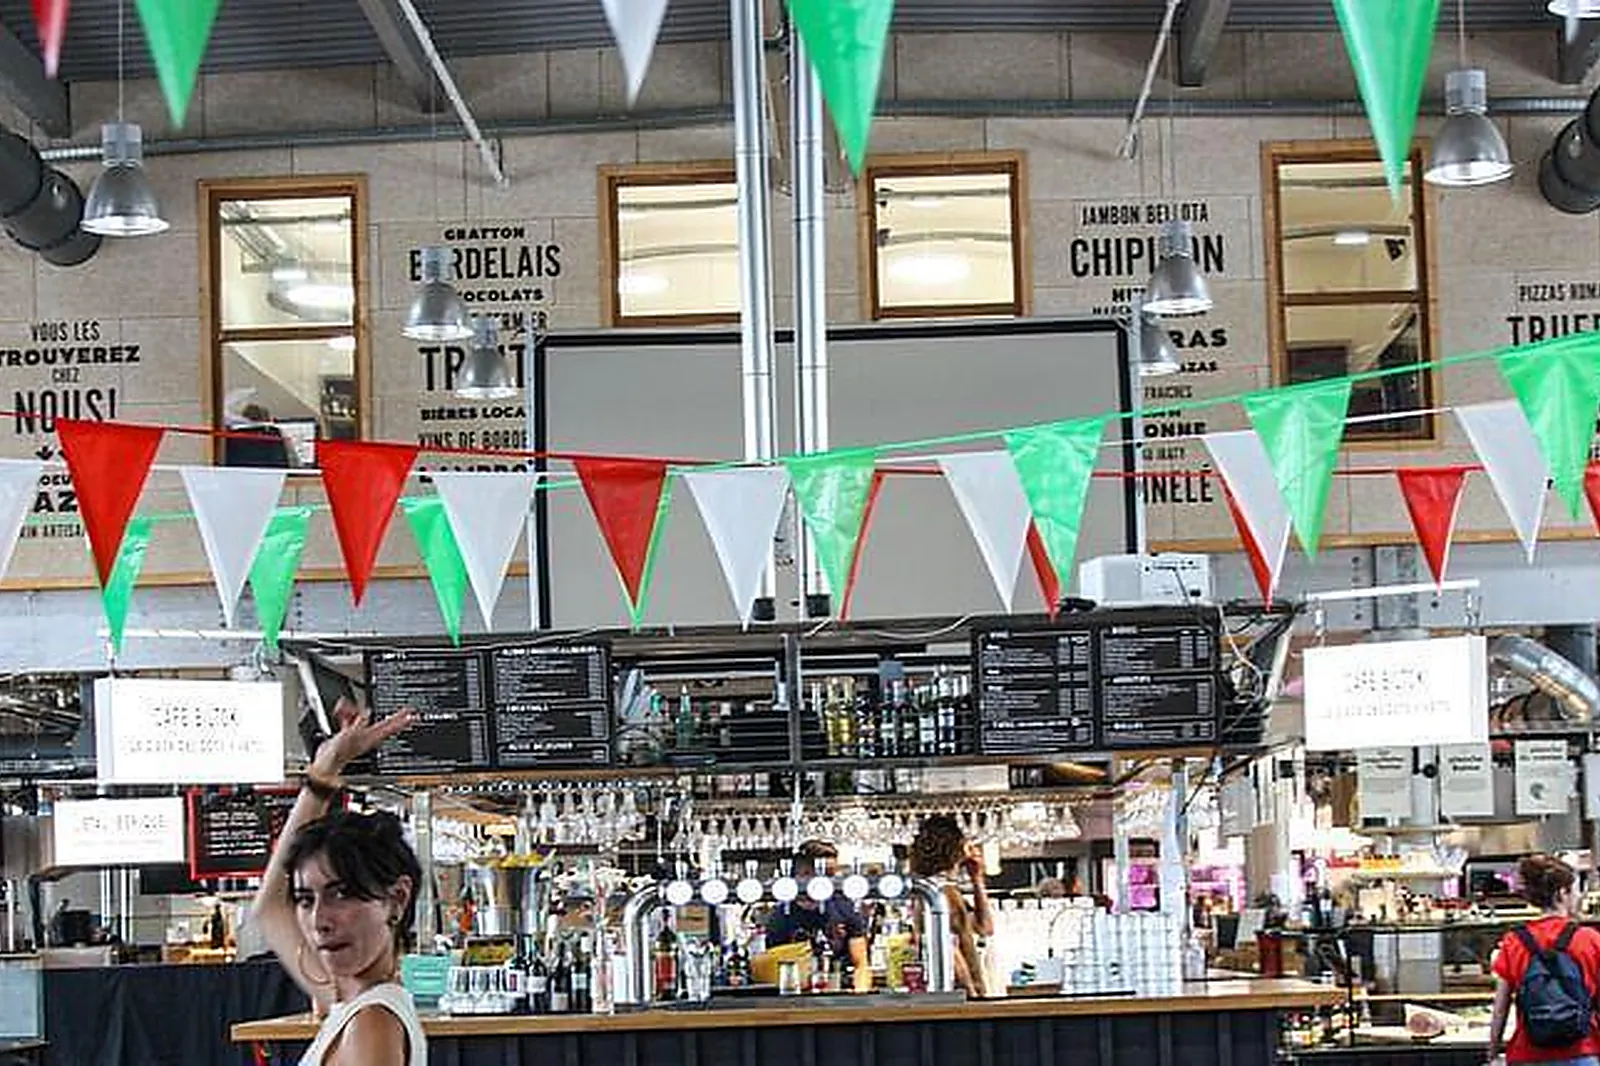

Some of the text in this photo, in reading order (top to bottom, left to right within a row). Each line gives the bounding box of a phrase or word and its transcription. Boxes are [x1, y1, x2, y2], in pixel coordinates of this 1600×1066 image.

[1082, 205, 1139, 225] JAMBON
[444, 227, 525, 240] GRATTON
[410, 245, 561, 281] BRDELAIS
[1071, 234, 1224, 277] CHIPIN
[459, 289, 544, 302] OCOLATS
[1519, 284, 1565, 301] PIZZAS
[31, 321, 101, 341] VOUS LES
[1168, 328, 1228, 348] RAS
[52, 367, 81, 382] CHEZ
[482, 406, 526, 419] LOCA
[1144, 422, 1206, 438] ONNE
